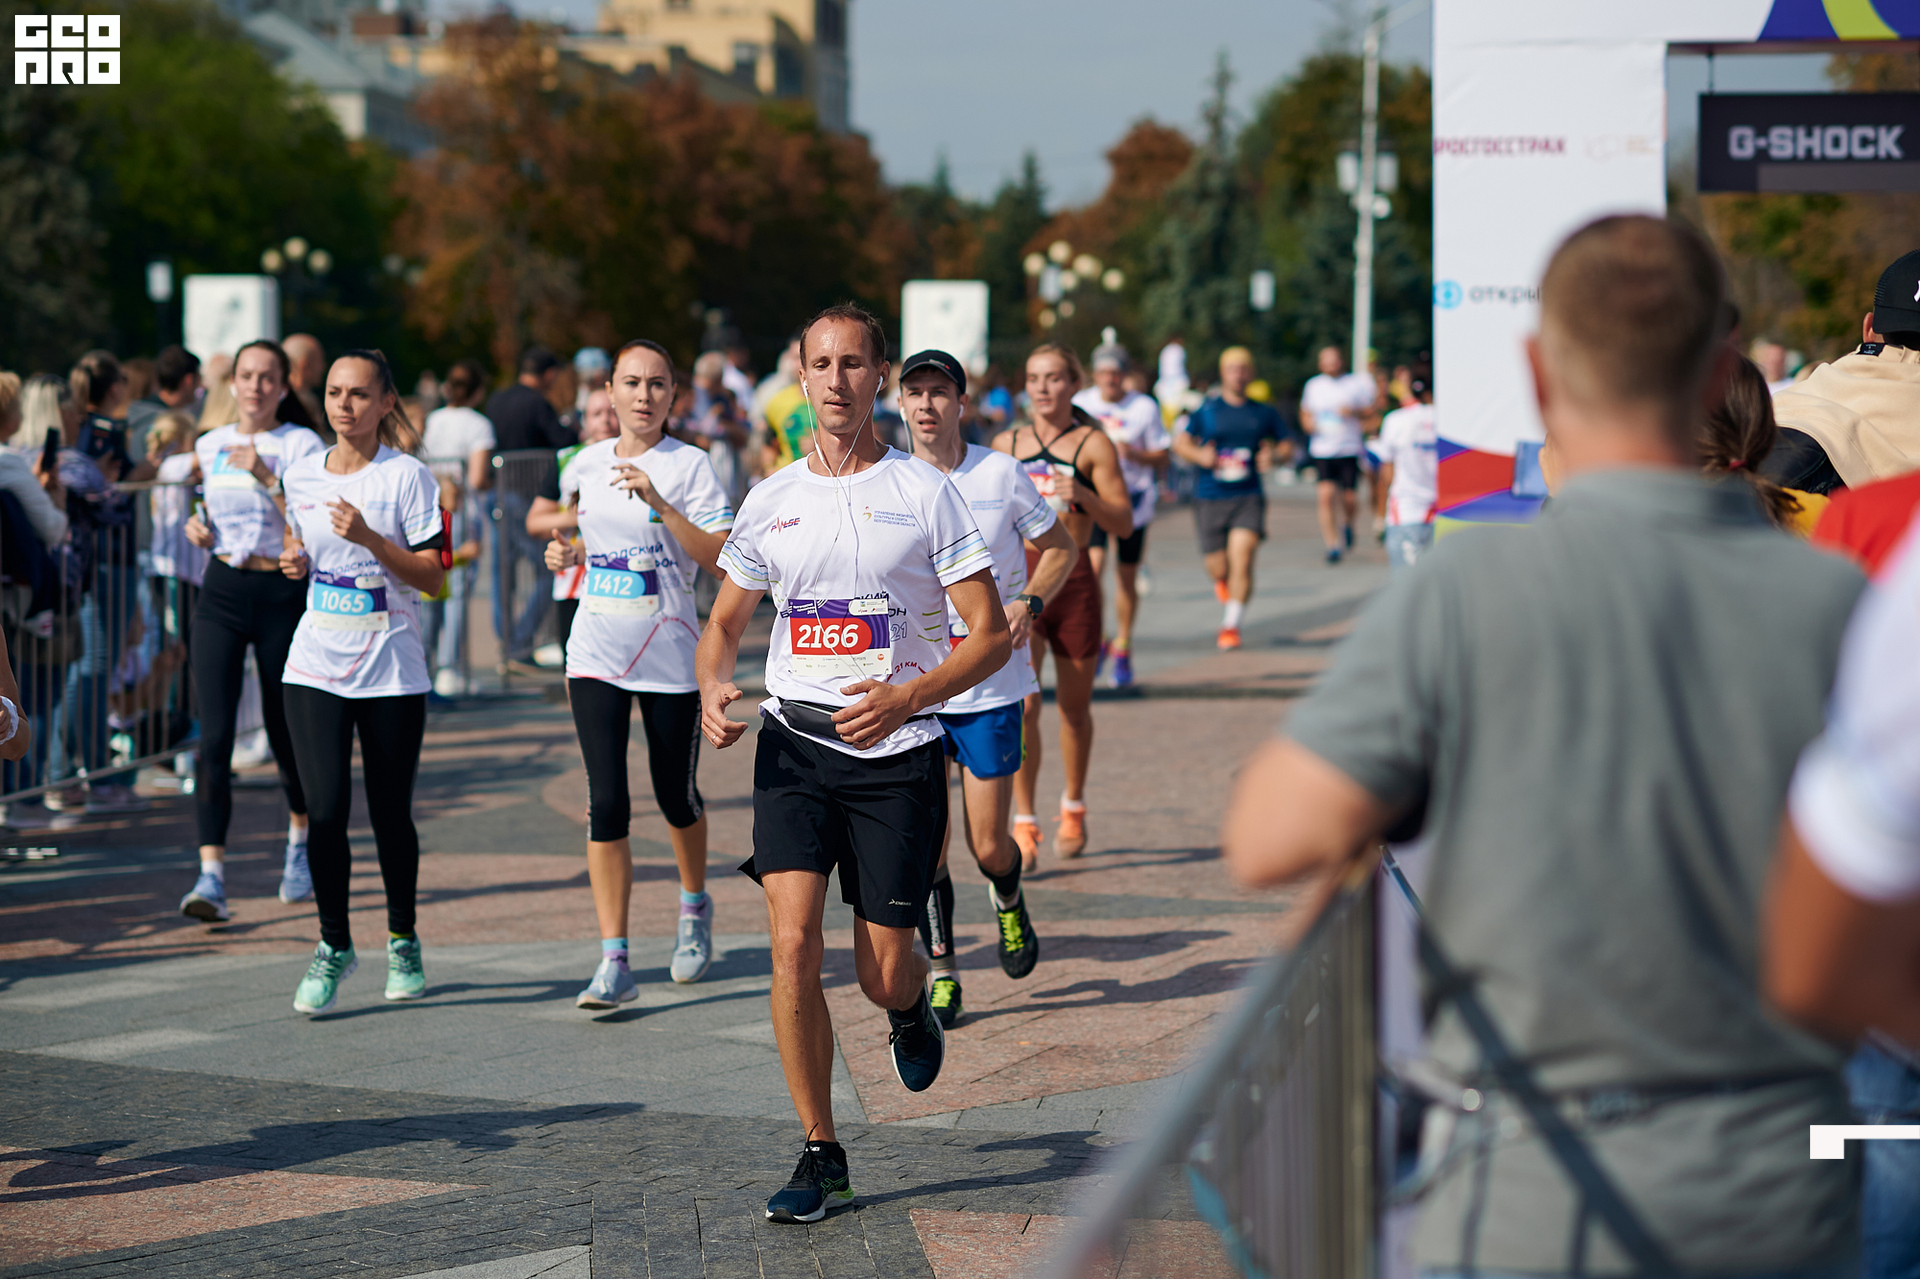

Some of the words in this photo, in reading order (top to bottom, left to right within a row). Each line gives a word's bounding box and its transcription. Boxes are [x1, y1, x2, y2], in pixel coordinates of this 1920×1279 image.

[1728, 124, 1905, 160] G-SHOCK
[1469, 285, 1541, 306] откры
[593, 573, 633, 595] 1412
[321, 590, 366, 613] 1065
[796, 624, 859, 649] 2166
[894, 662, 903, 673] 21
